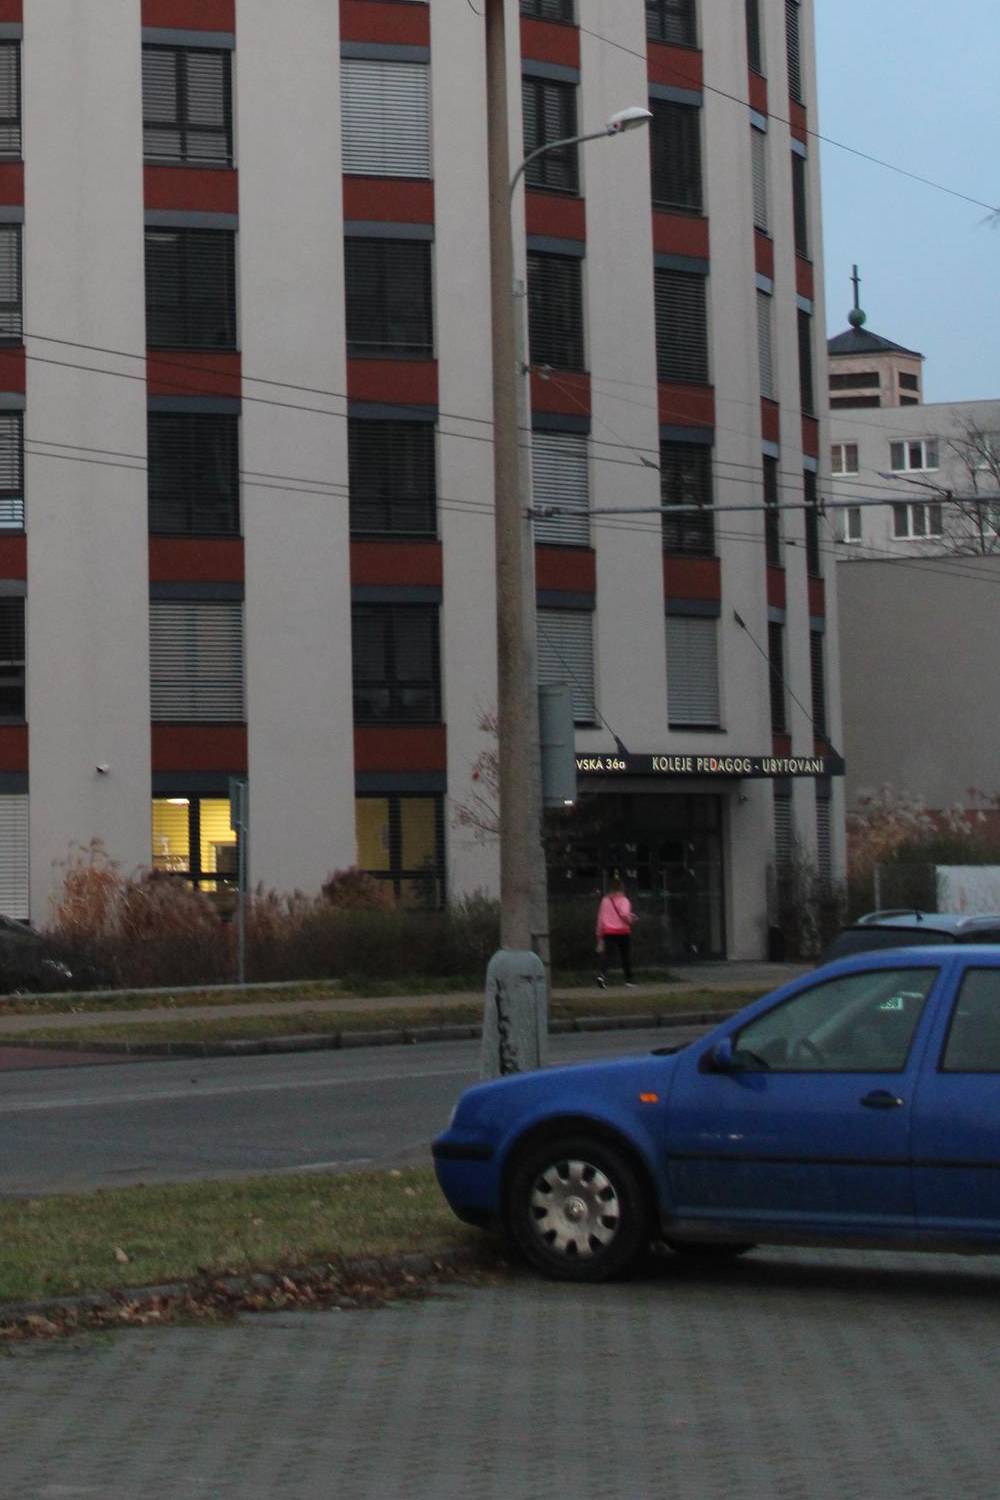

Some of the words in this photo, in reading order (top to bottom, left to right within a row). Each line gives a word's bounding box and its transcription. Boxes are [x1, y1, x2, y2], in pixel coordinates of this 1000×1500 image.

[605, 758, 626, 770] 36a
[652, 757, 693, 771] KOLEJE
[697, 758, 751, 772] PEDAGOG
[762, 757, 825, 773] UBYTOVÁNÍ
